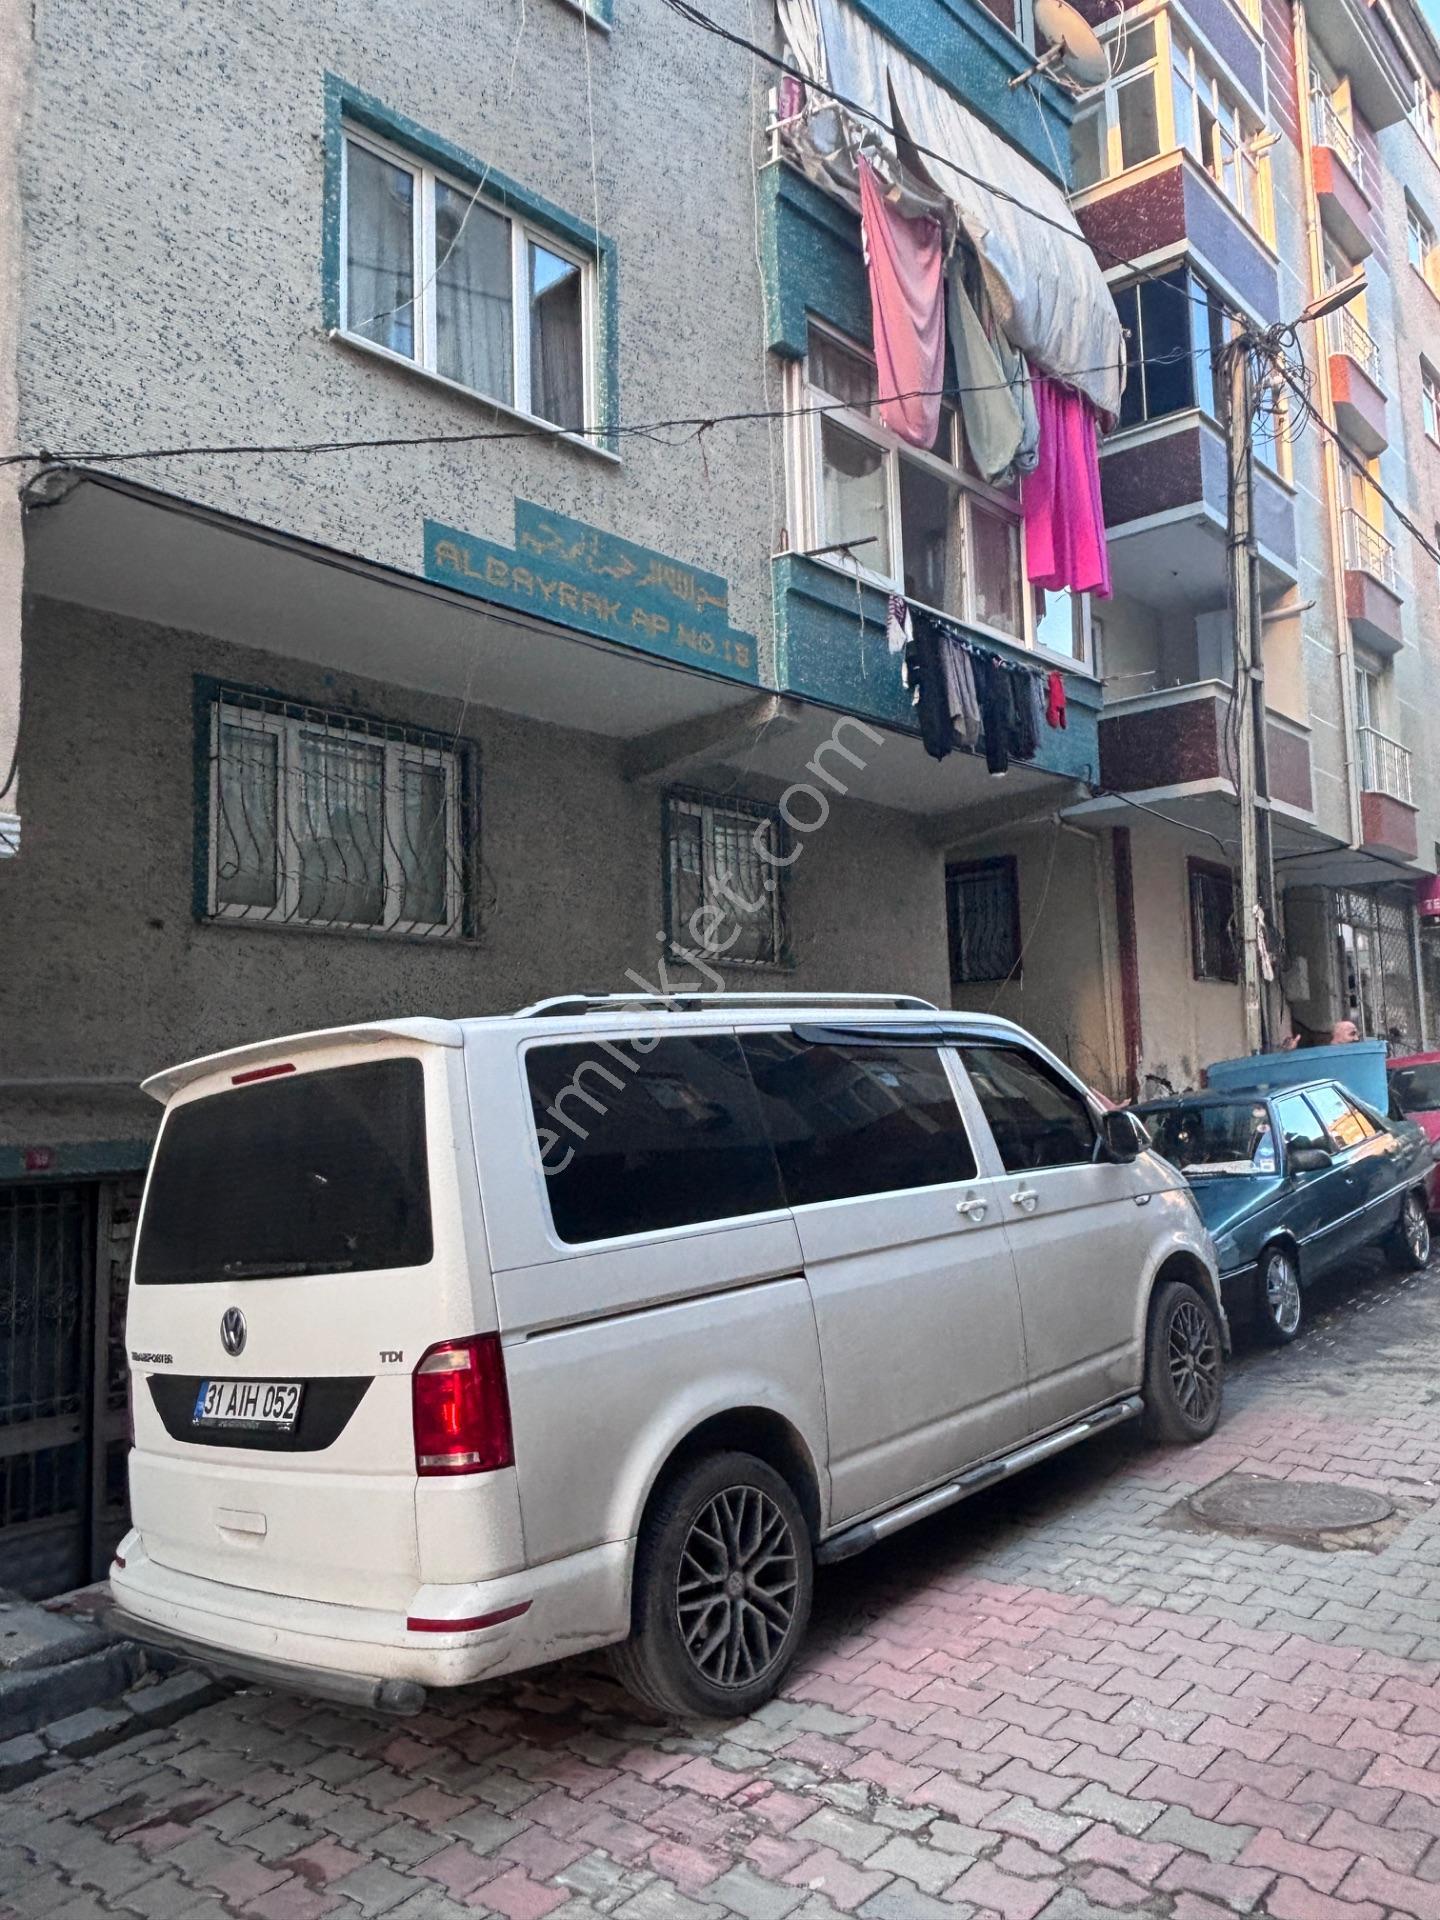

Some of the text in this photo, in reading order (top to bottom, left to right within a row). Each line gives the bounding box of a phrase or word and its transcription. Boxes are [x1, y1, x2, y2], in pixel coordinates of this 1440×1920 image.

[435, 538, 622, 626] ALBAYRAK
[379, 1350, 404, 1364] TDI
[204, 1384, 298, 1419] 31 AIH 052
